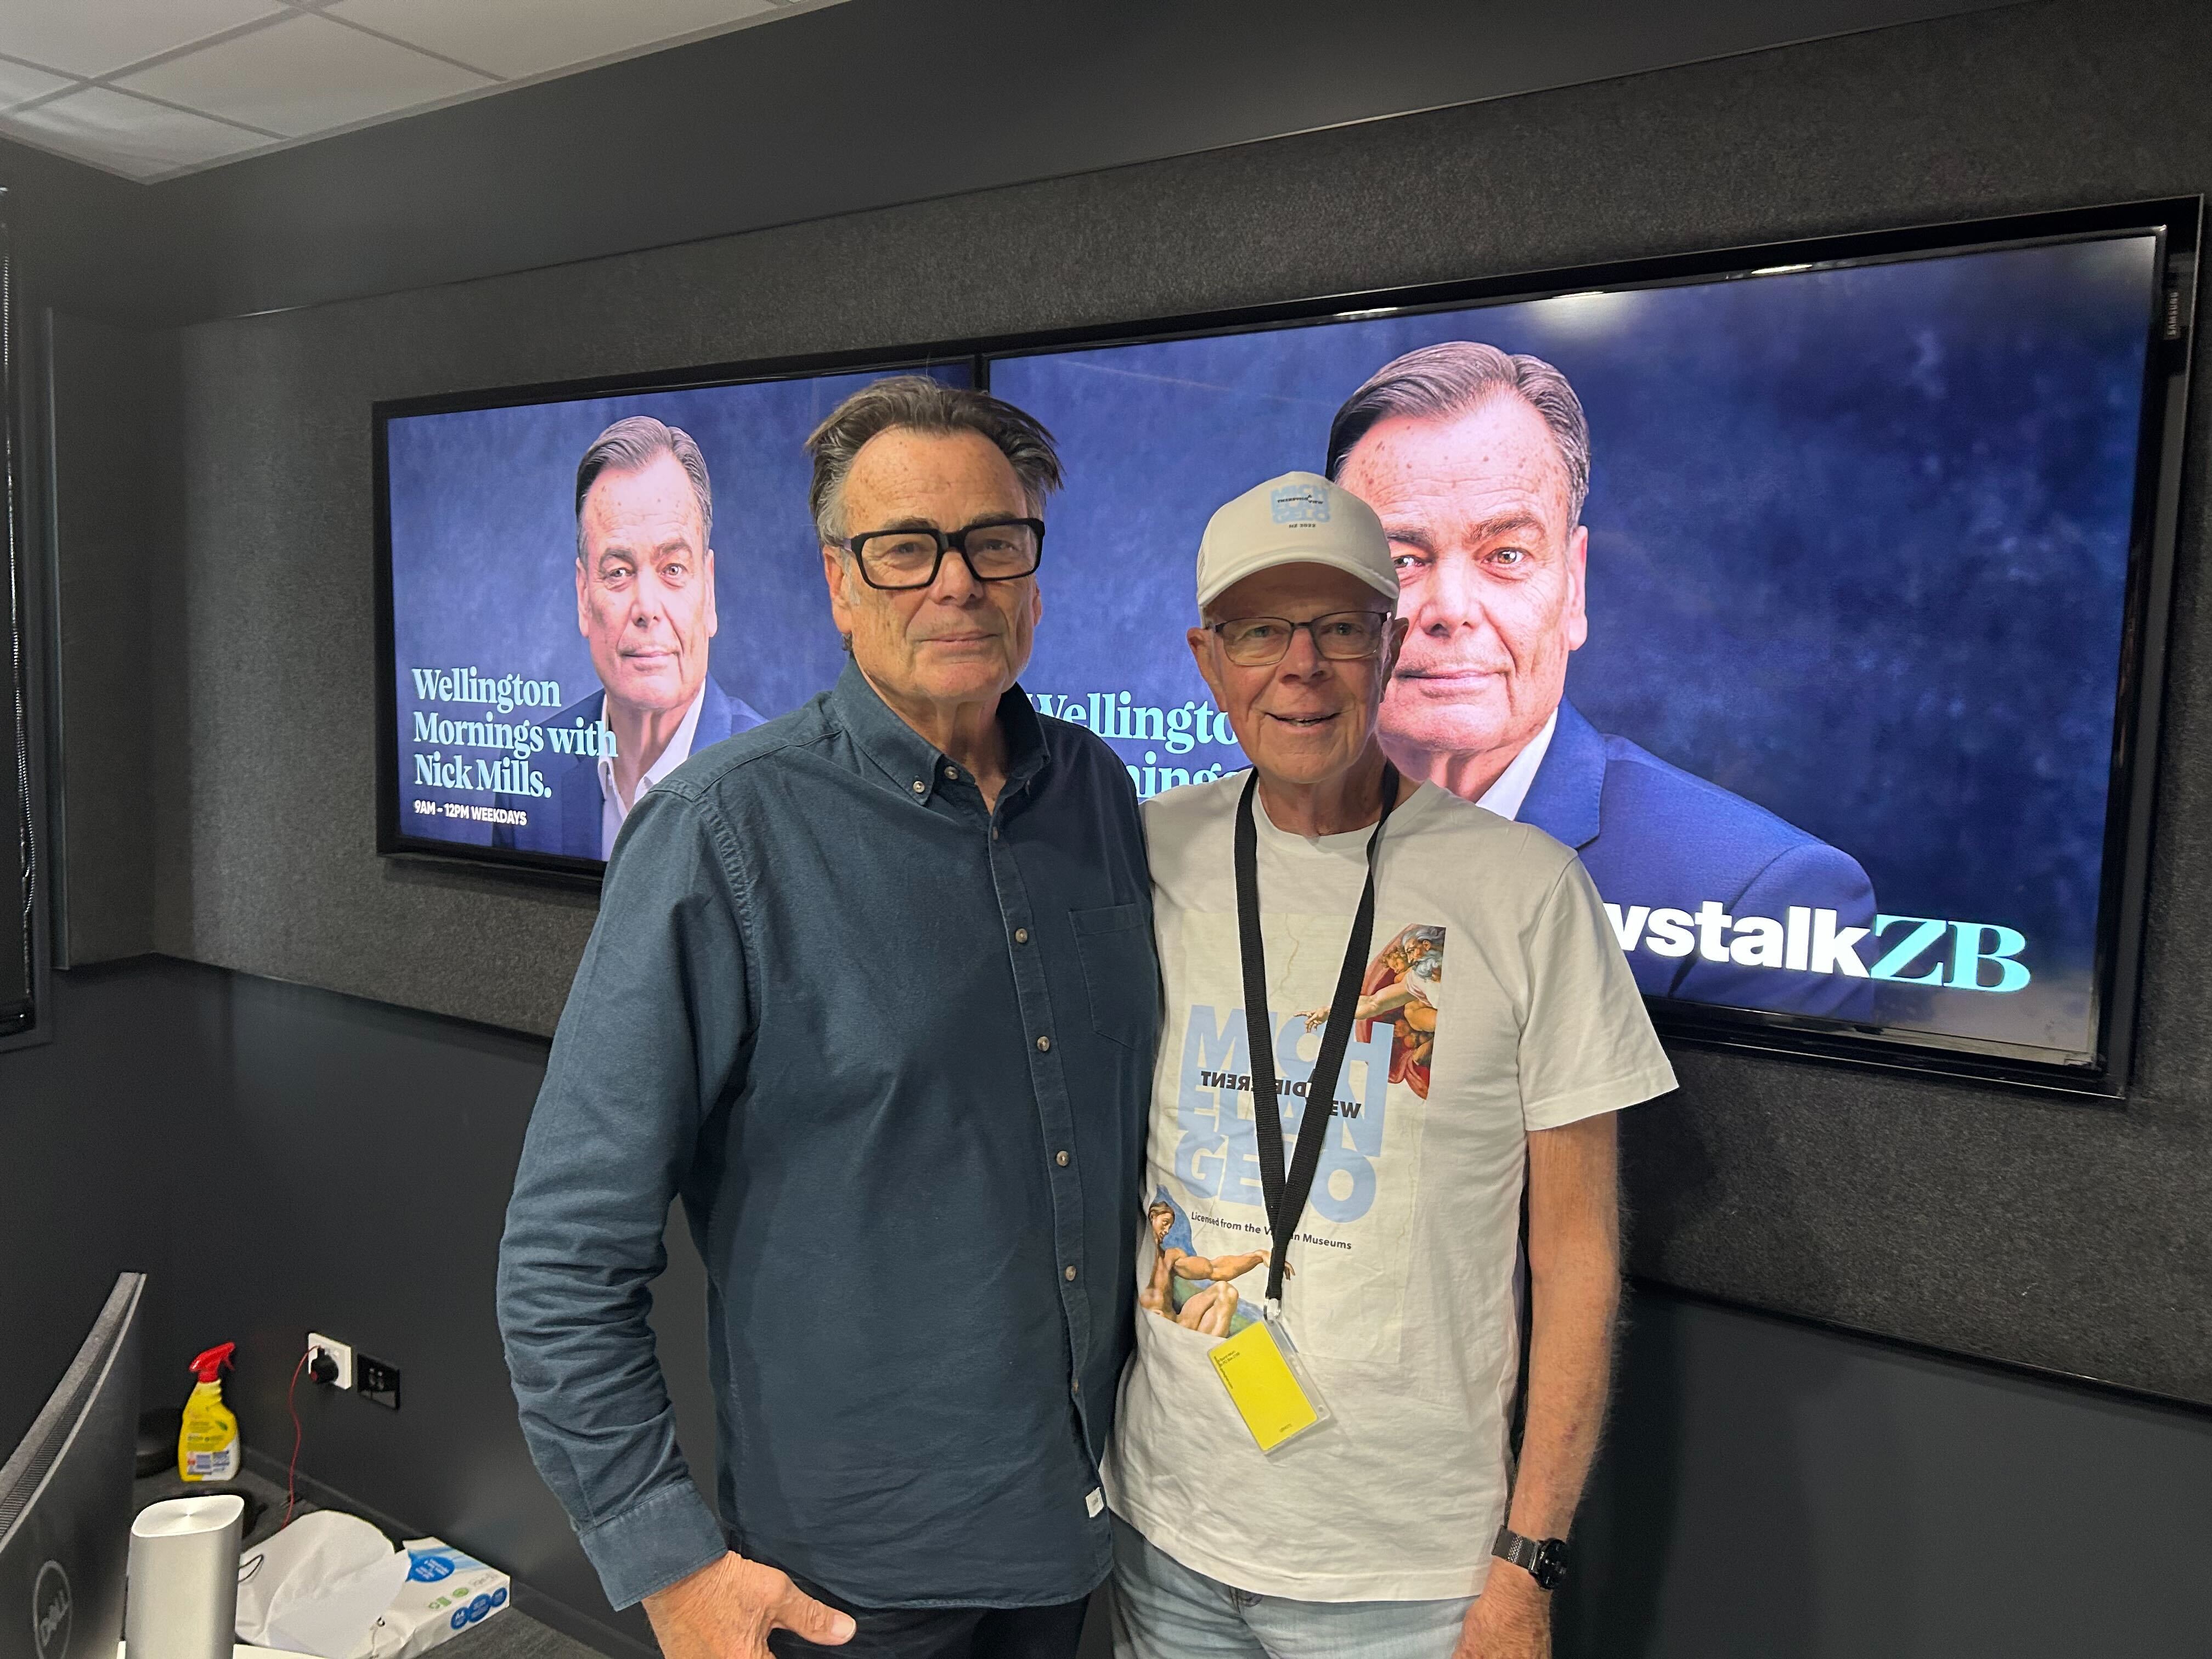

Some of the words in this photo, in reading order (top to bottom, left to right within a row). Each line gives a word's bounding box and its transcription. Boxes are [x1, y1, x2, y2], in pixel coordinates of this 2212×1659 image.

[412, 666, 562, 713] Wellington
[414, 712, 544, 759] Mornings
[547, 716, 618, 757] with
[1026, 691, 1239, 754] Wellingto
[415, 751, 473, 790] Nick
[476, 757, 552, 798] Mills.
[414, 800, 436, 815] 9AM
[444, 803, 469, 819] 12PM
[471, 807, 527, 826] WEEKDAYS
[1181, 1005, 1393, 1089] MCH
[1175, 1129, 1376, 1223] GEO
[1191, 1211, 1219, 1227] Licensed
[1221, 1221, 1242, 1231] from
[1245, 1223, 1261, 1234] the
[1303, 1233, 1352, 1250] Museums
